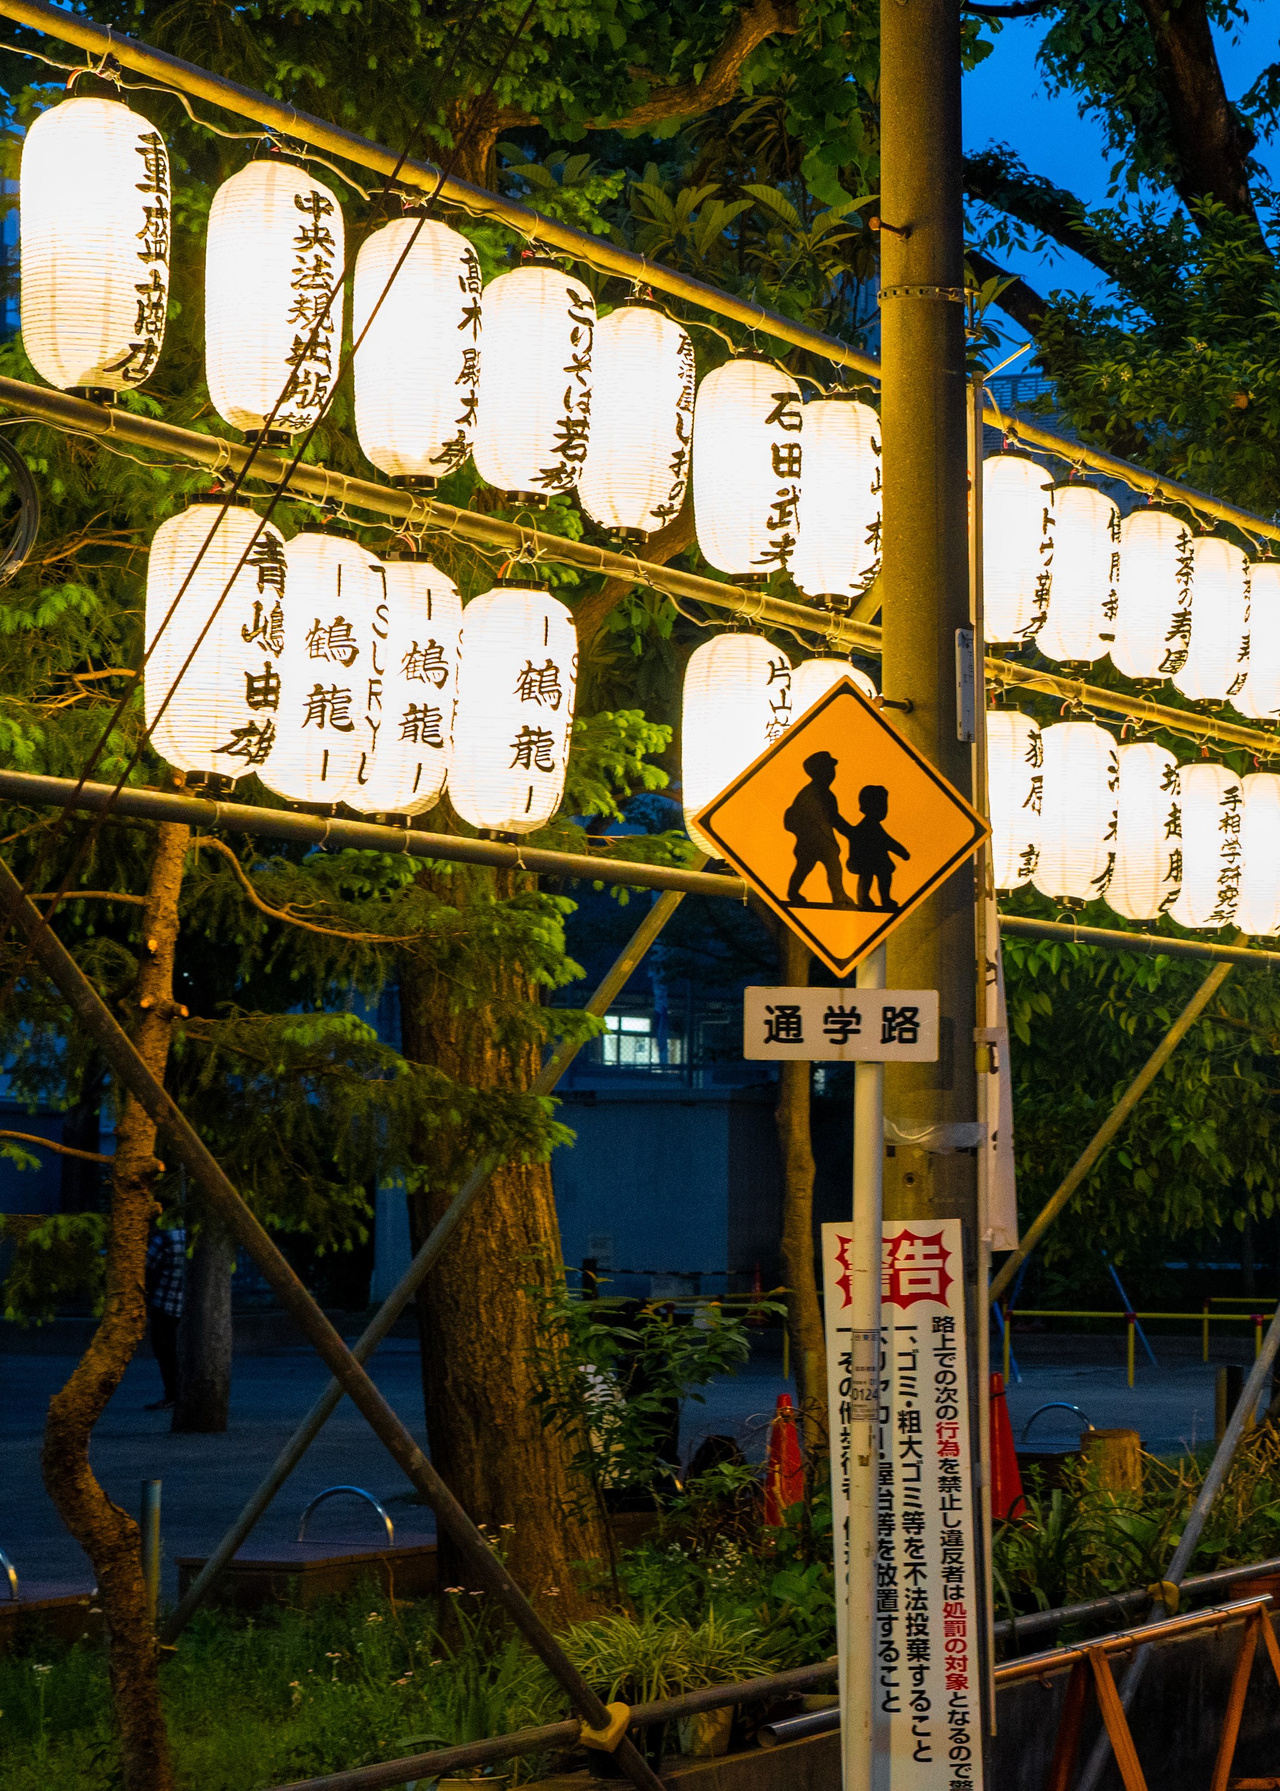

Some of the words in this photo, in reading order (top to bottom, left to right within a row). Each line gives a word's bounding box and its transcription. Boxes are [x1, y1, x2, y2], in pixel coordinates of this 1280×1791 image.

[1203, 785, 1244, 923] 手相学研究所
[762, 1005, 921, 1045] 通学路
